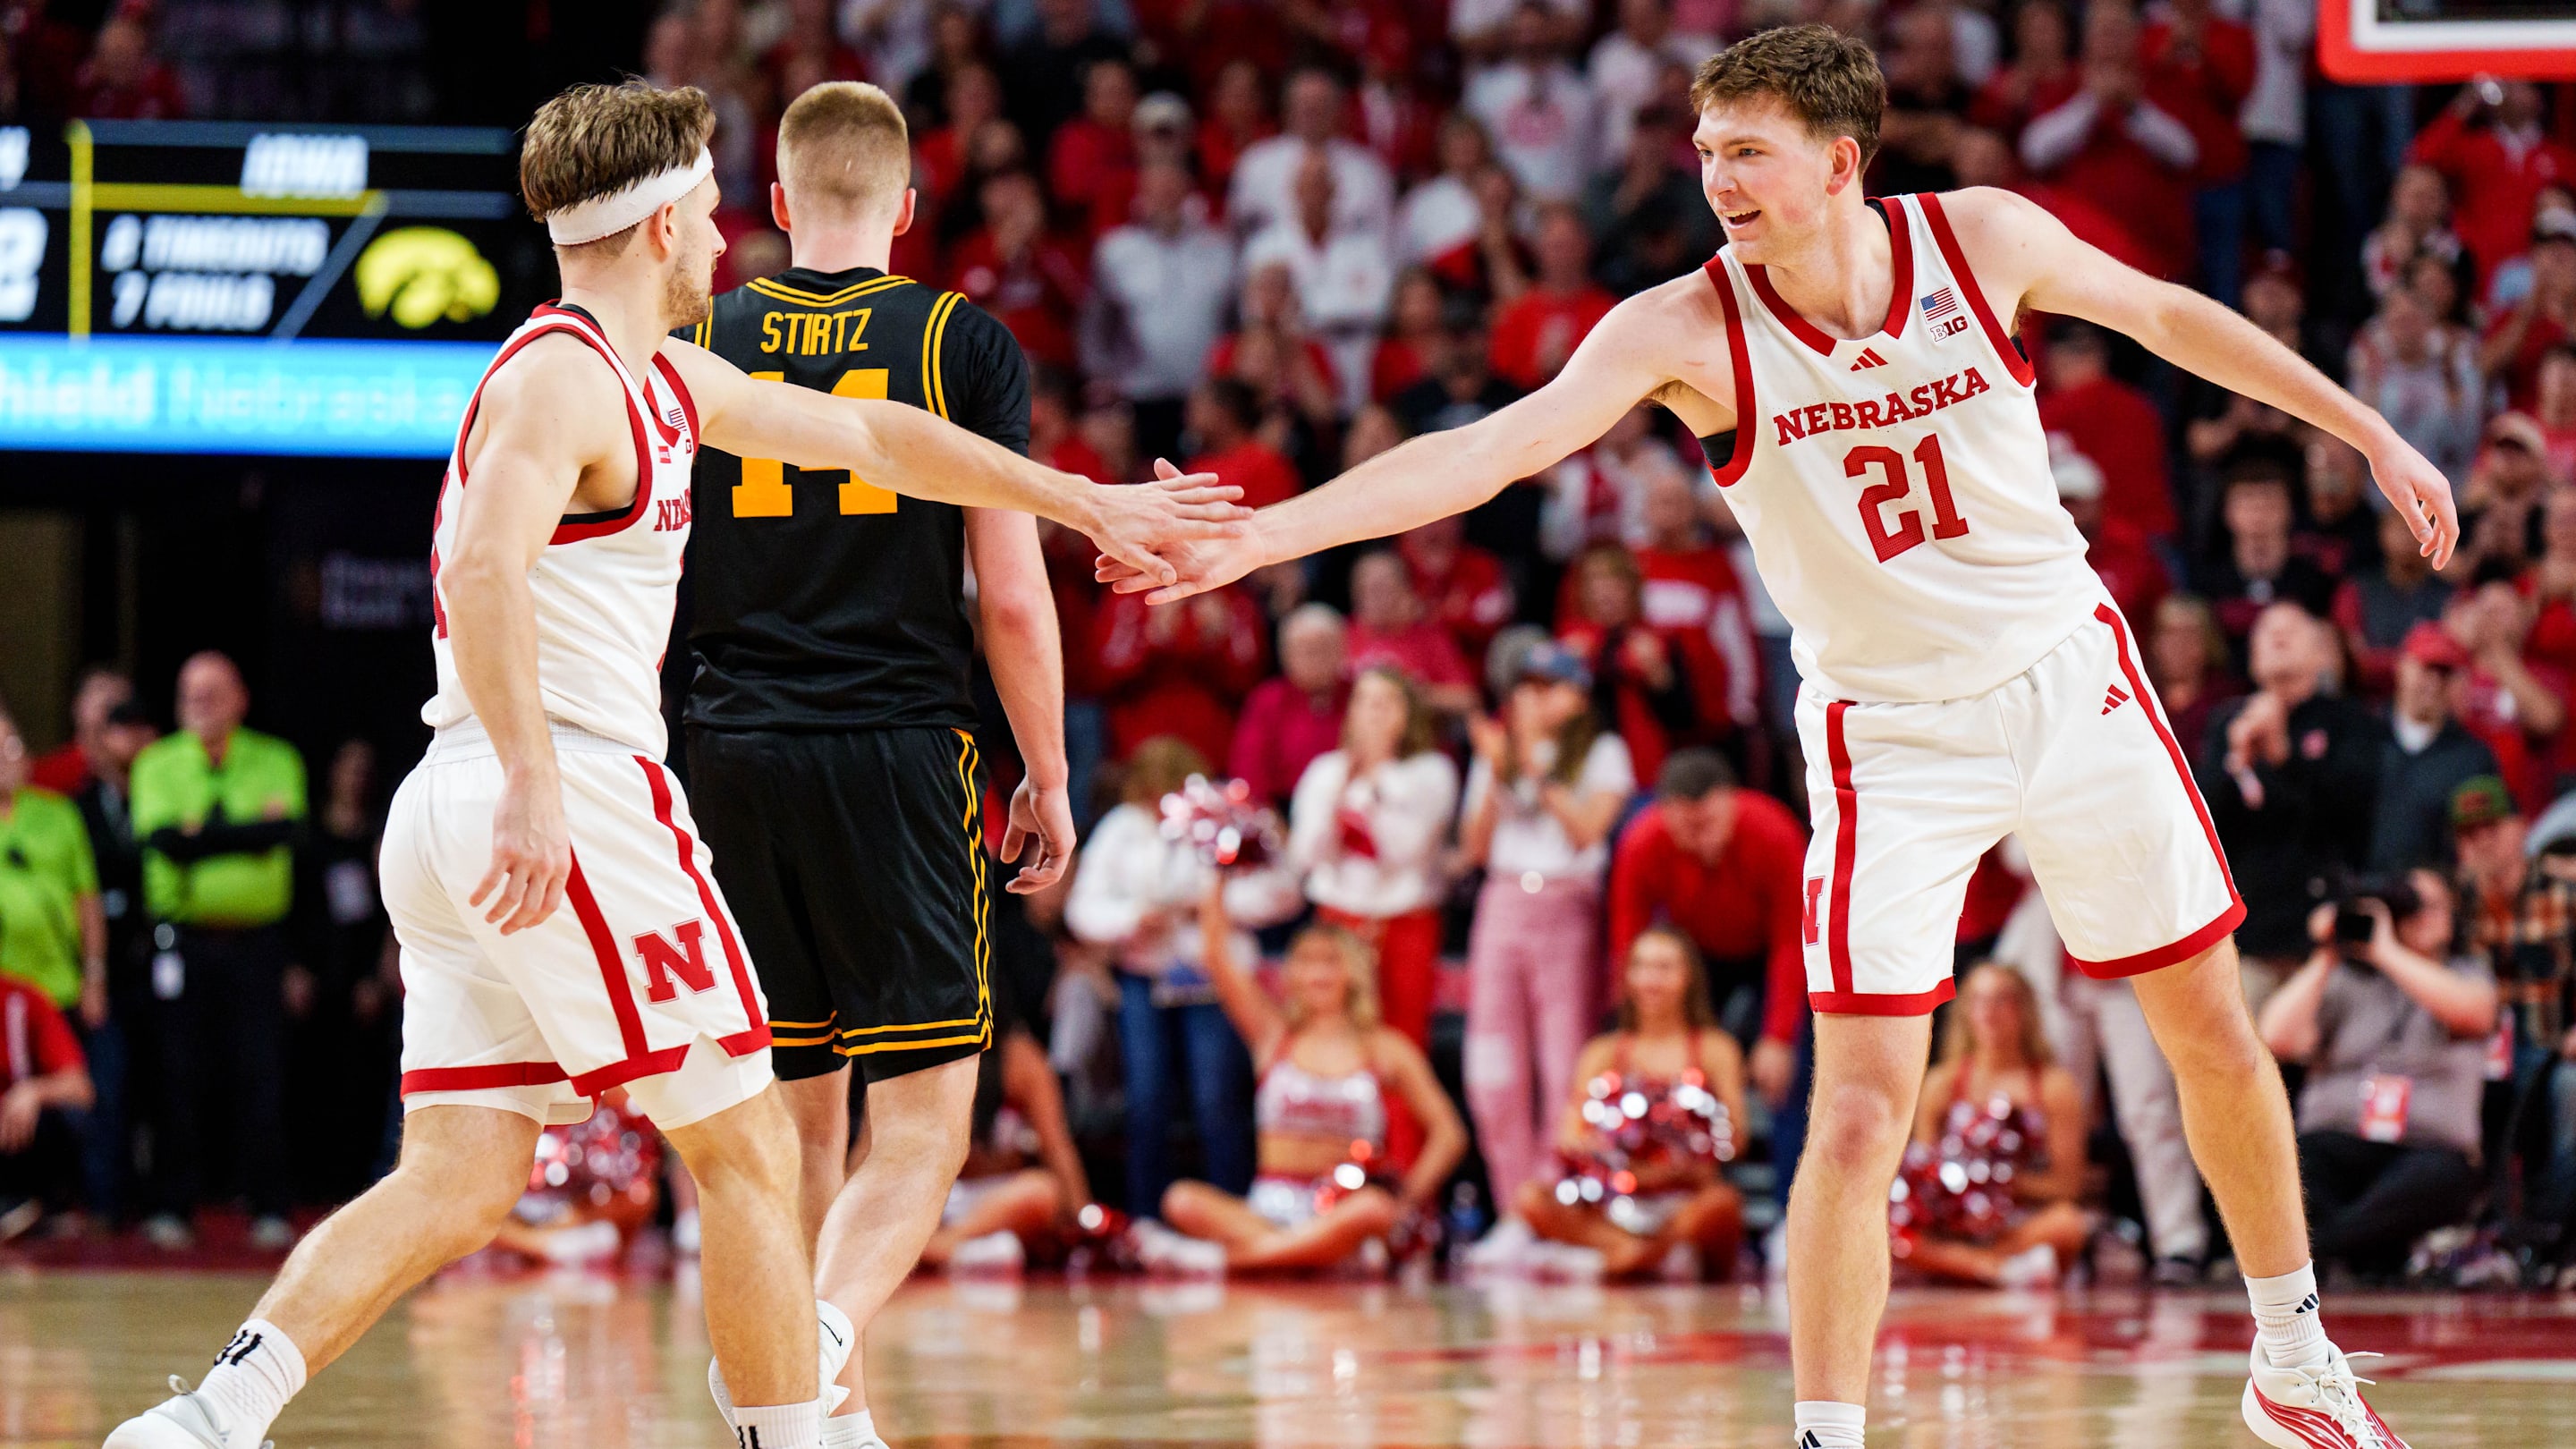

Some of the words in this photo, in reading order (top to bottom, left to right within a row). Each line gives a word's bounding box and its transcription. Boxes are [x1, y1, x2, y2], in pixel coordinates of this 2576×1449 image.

[142, 214, 330, 275] TIMEOUTS
[144, 272, 275, 330] FOULS
[760, 308, 872, 355] STIRTZ
[1773, 367, 1990, 446] NEBRASKA
[1843, 433, 1970, 564] 21
[631, 918, 718, 1004] N
